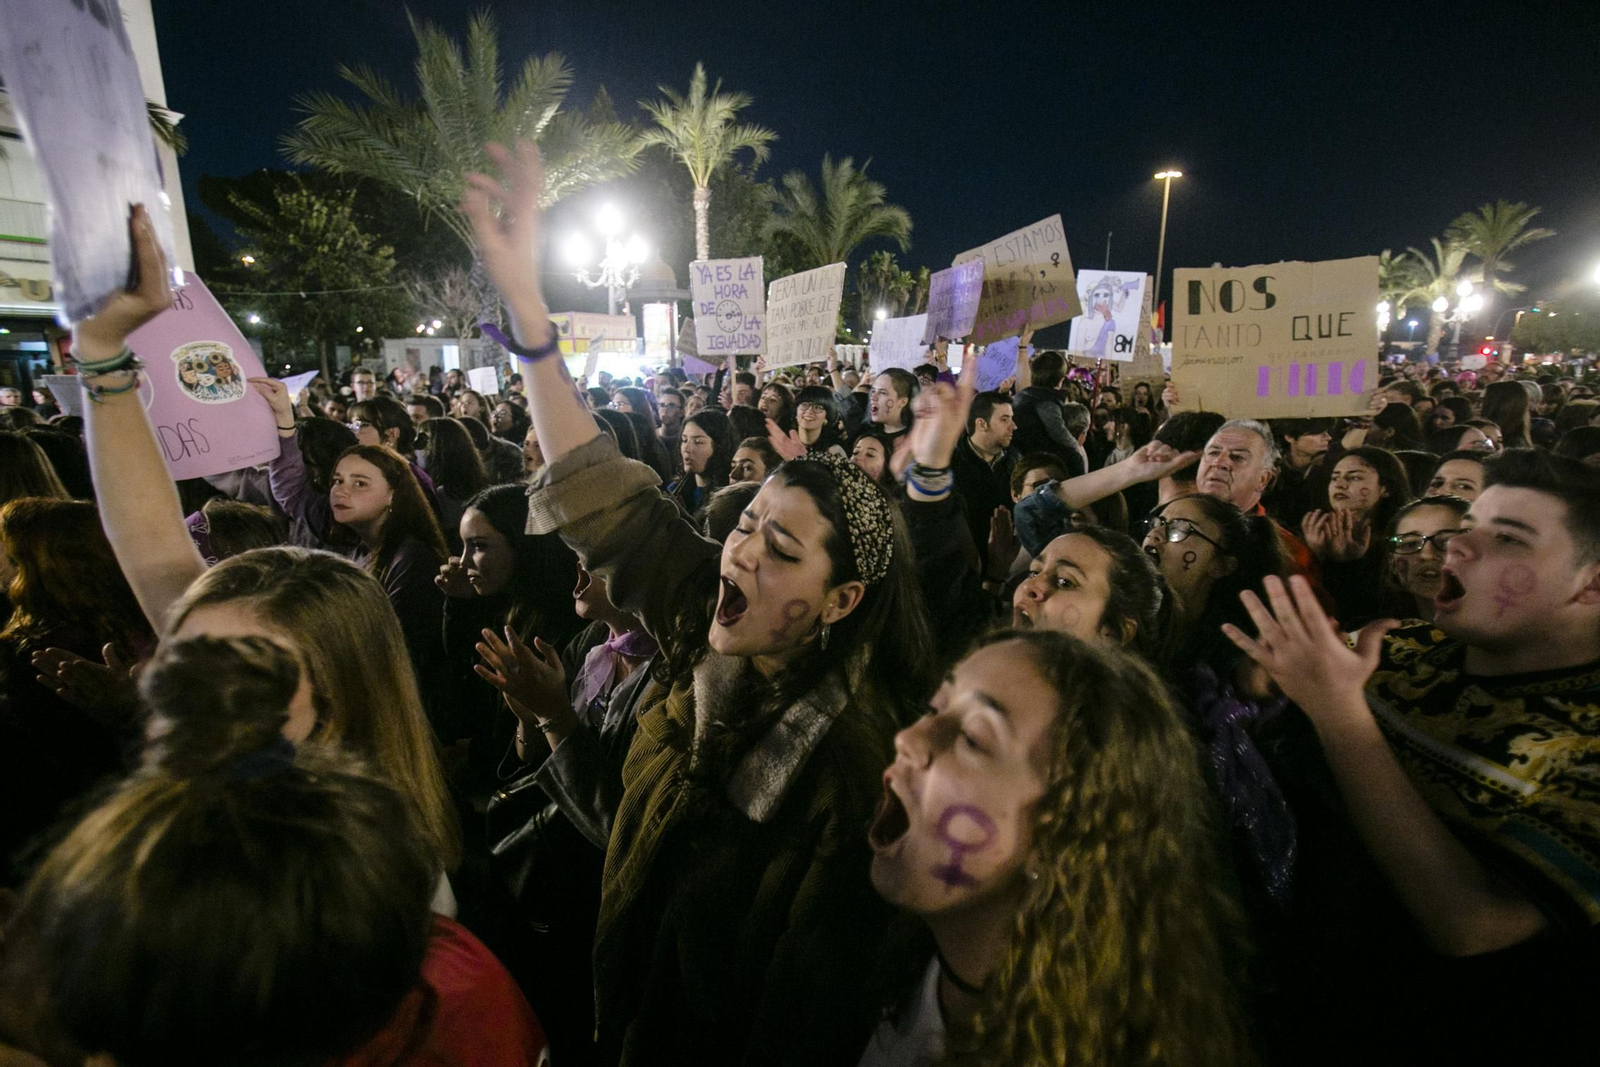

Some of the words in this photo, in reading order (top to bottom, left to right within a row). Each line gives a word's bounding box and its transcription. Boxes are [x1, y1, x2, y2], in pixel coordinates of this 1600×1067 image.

[993, 220, 1063, 268] ESTAMOS
[696, 264, 713, 285] YA
[717, 265, 732, 282] ES
[739, 262, 756, 281] LA
[714, 284, 749, 300] HORA
[775, 277, 798, 302] ERA
[801, 273, 818, 295] UN
[1187, 275, 1276, 316] NOS
[173, 289, 194, 311] AS
[700, 302, 716, 316] DE
[744, 316, 761, 331] LA
[771, 305, 788, 324] TAN
[1179, 322, 1261, 349] TANTO
[1291, 311, 1356, 342] QUE
[707, 333, 762, 350] IGUALDAD
[1113, 333, 1134, 353] 8M
[157, 417, 211, 462] DAS
